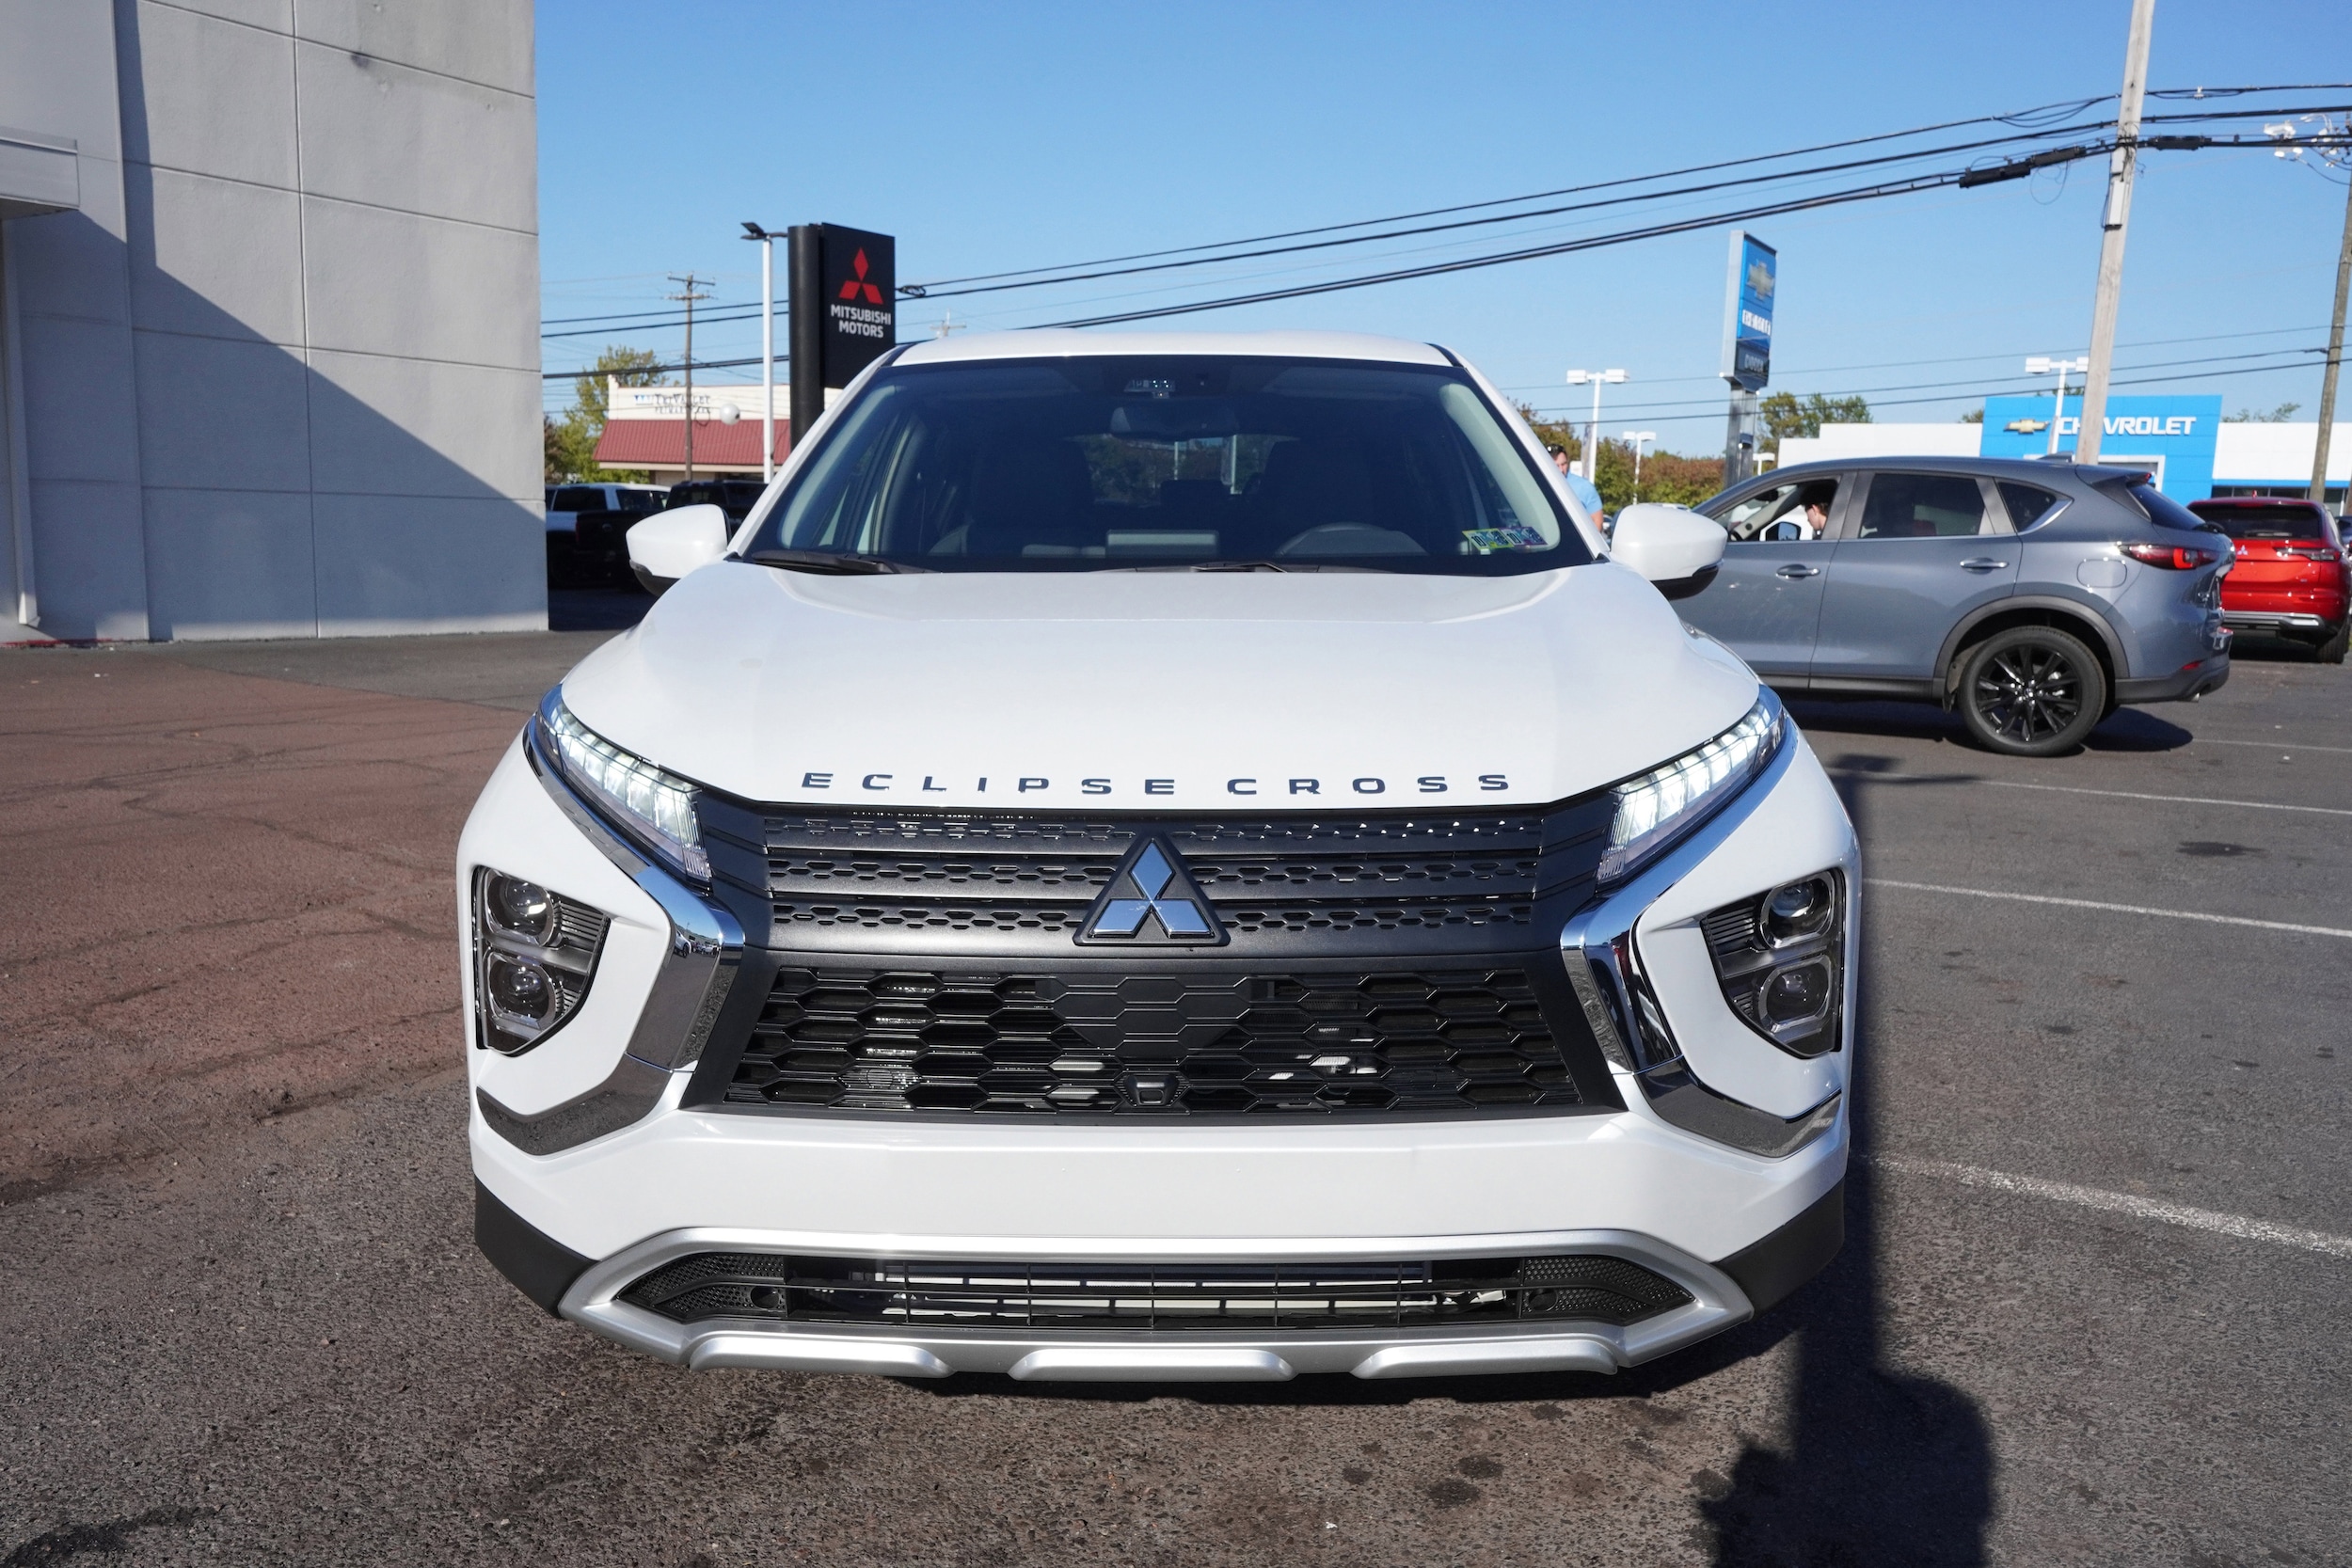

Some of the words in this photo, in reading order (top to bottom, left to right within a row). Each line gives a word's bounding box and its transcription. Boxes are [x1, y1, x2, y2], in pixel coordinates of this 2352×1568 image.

[831, 304, 892, 325] MITSUBISHI
[839, 320, 883, 338] MOTORS
[2058, 417, 2197, 436] CVROLET
[801, 772, 1175, 796] ECLIPSE
[1226, 774, 1509, 796] CROSS
